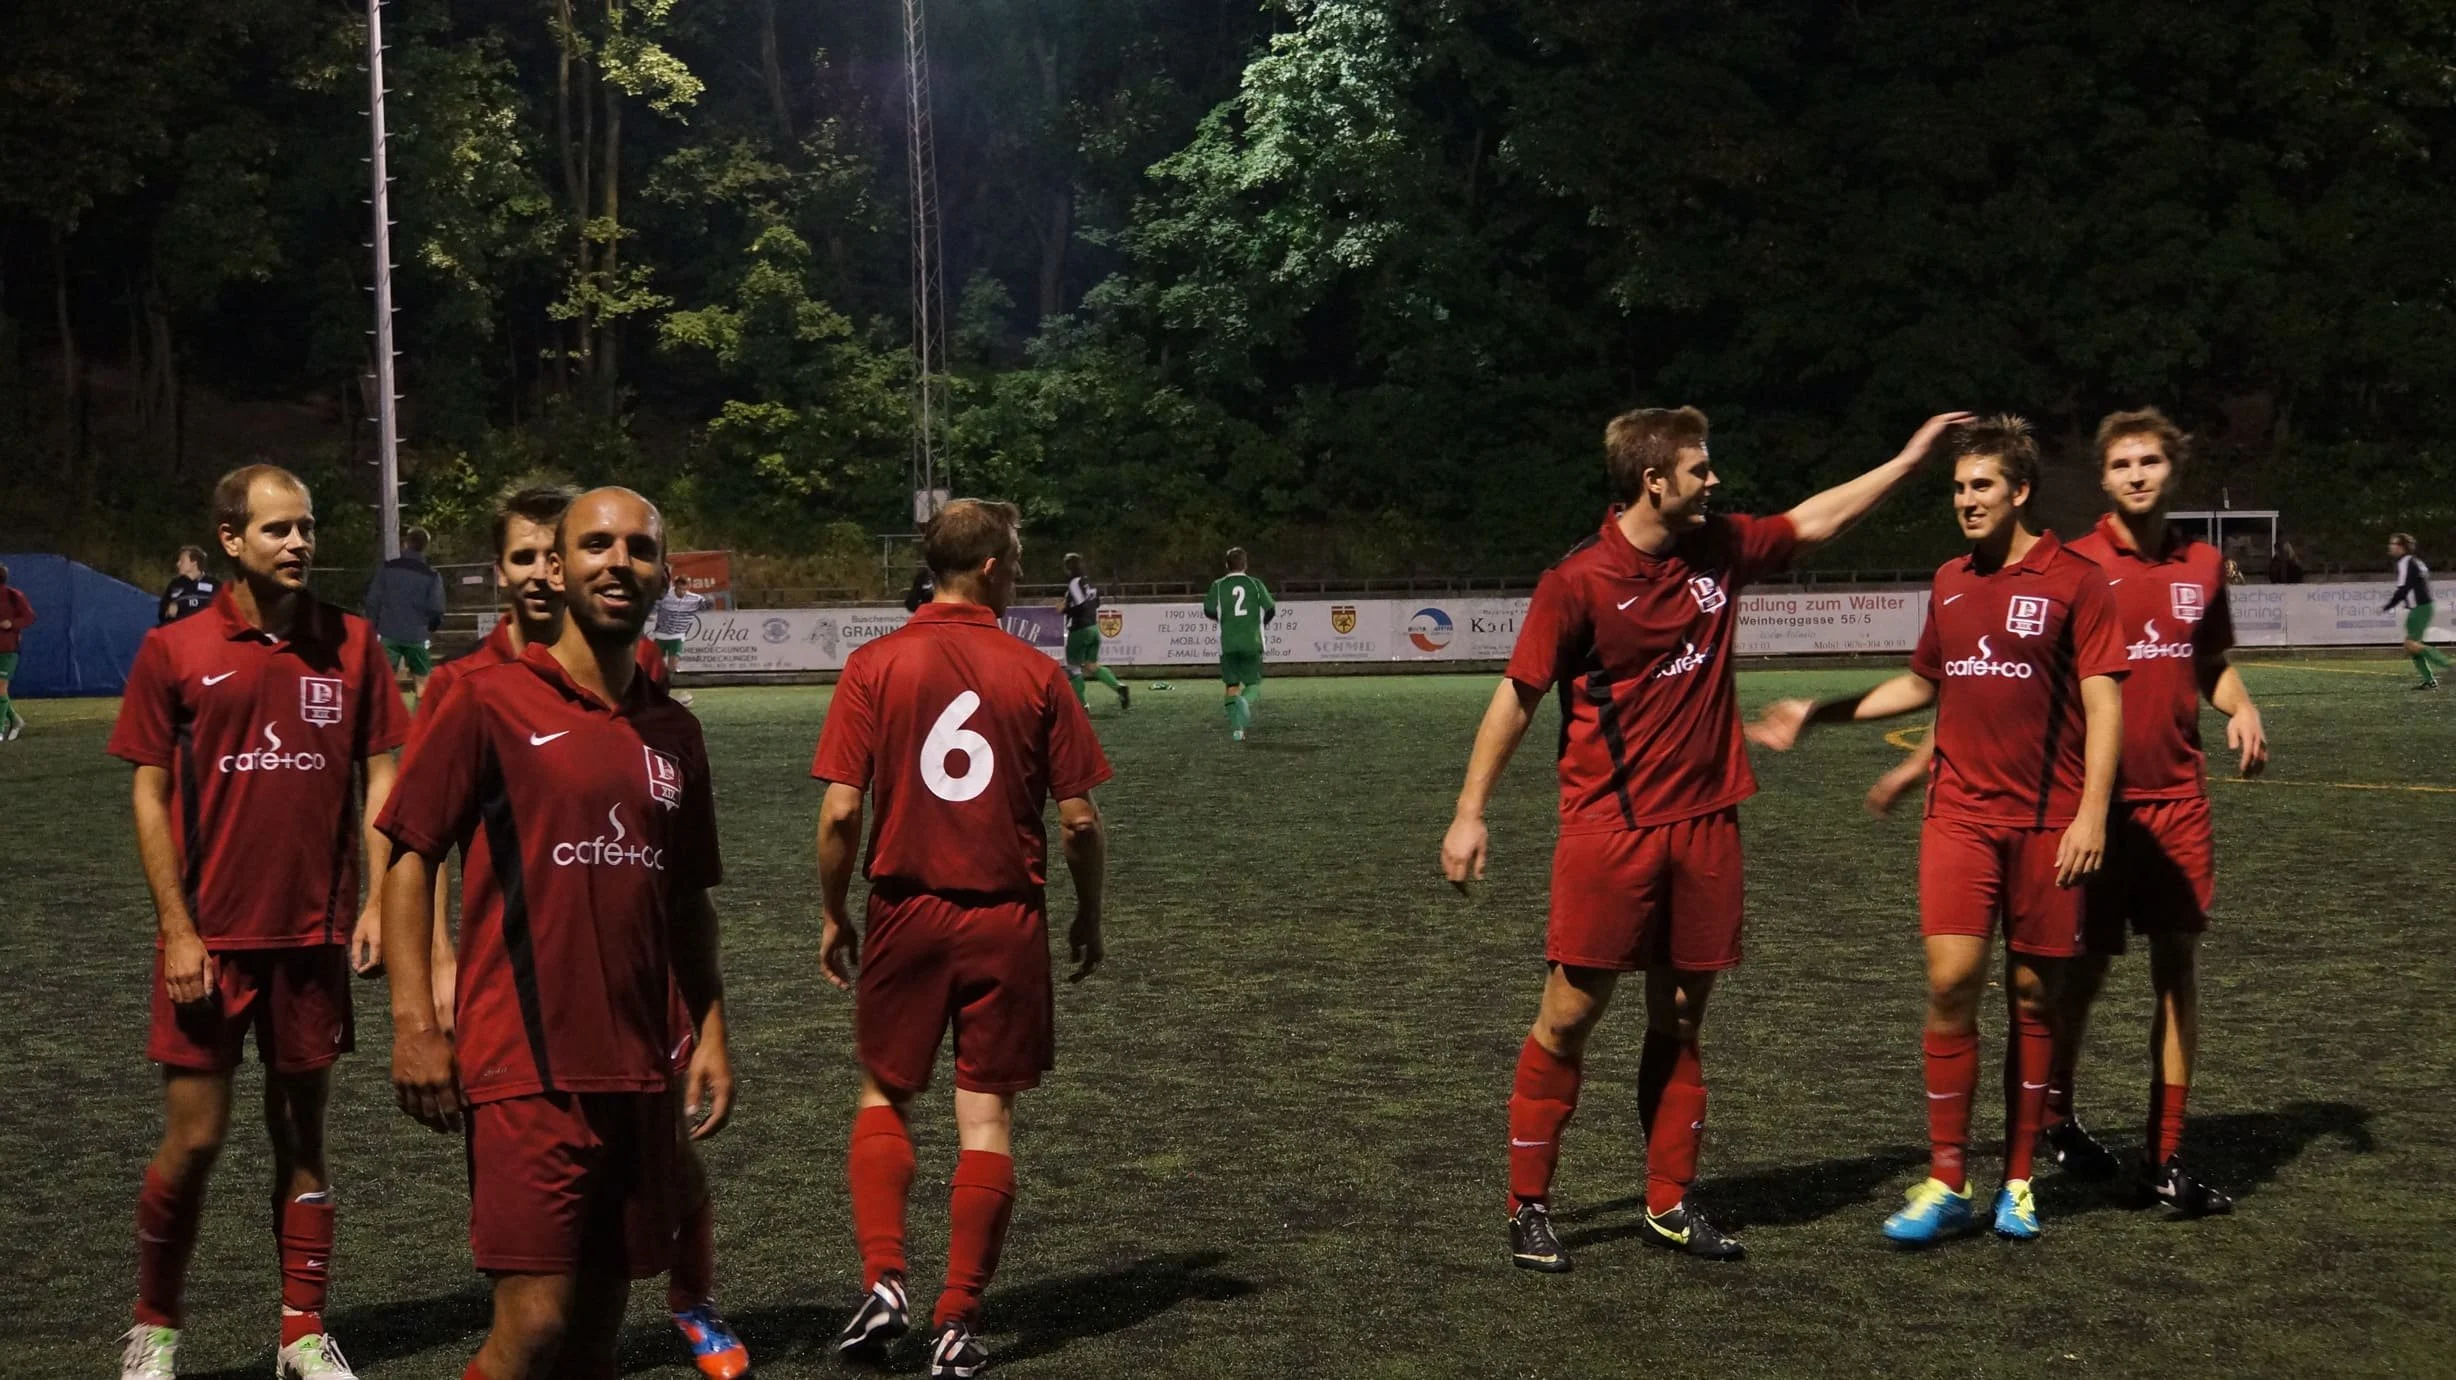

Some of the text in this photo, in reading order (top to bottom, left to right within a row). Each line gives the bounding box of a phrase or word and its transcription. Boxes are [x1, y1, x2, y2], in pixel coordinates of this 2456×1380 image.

[1232, 585, 1248, 616] 2
[1738, 595, 1905, 614] ndlung zum Walter
[684, 613, 750, 646] Dujka
[1738, 613, 1871, 627] Weinberggasse 55/5
[920, 690, 995, 802] 6
